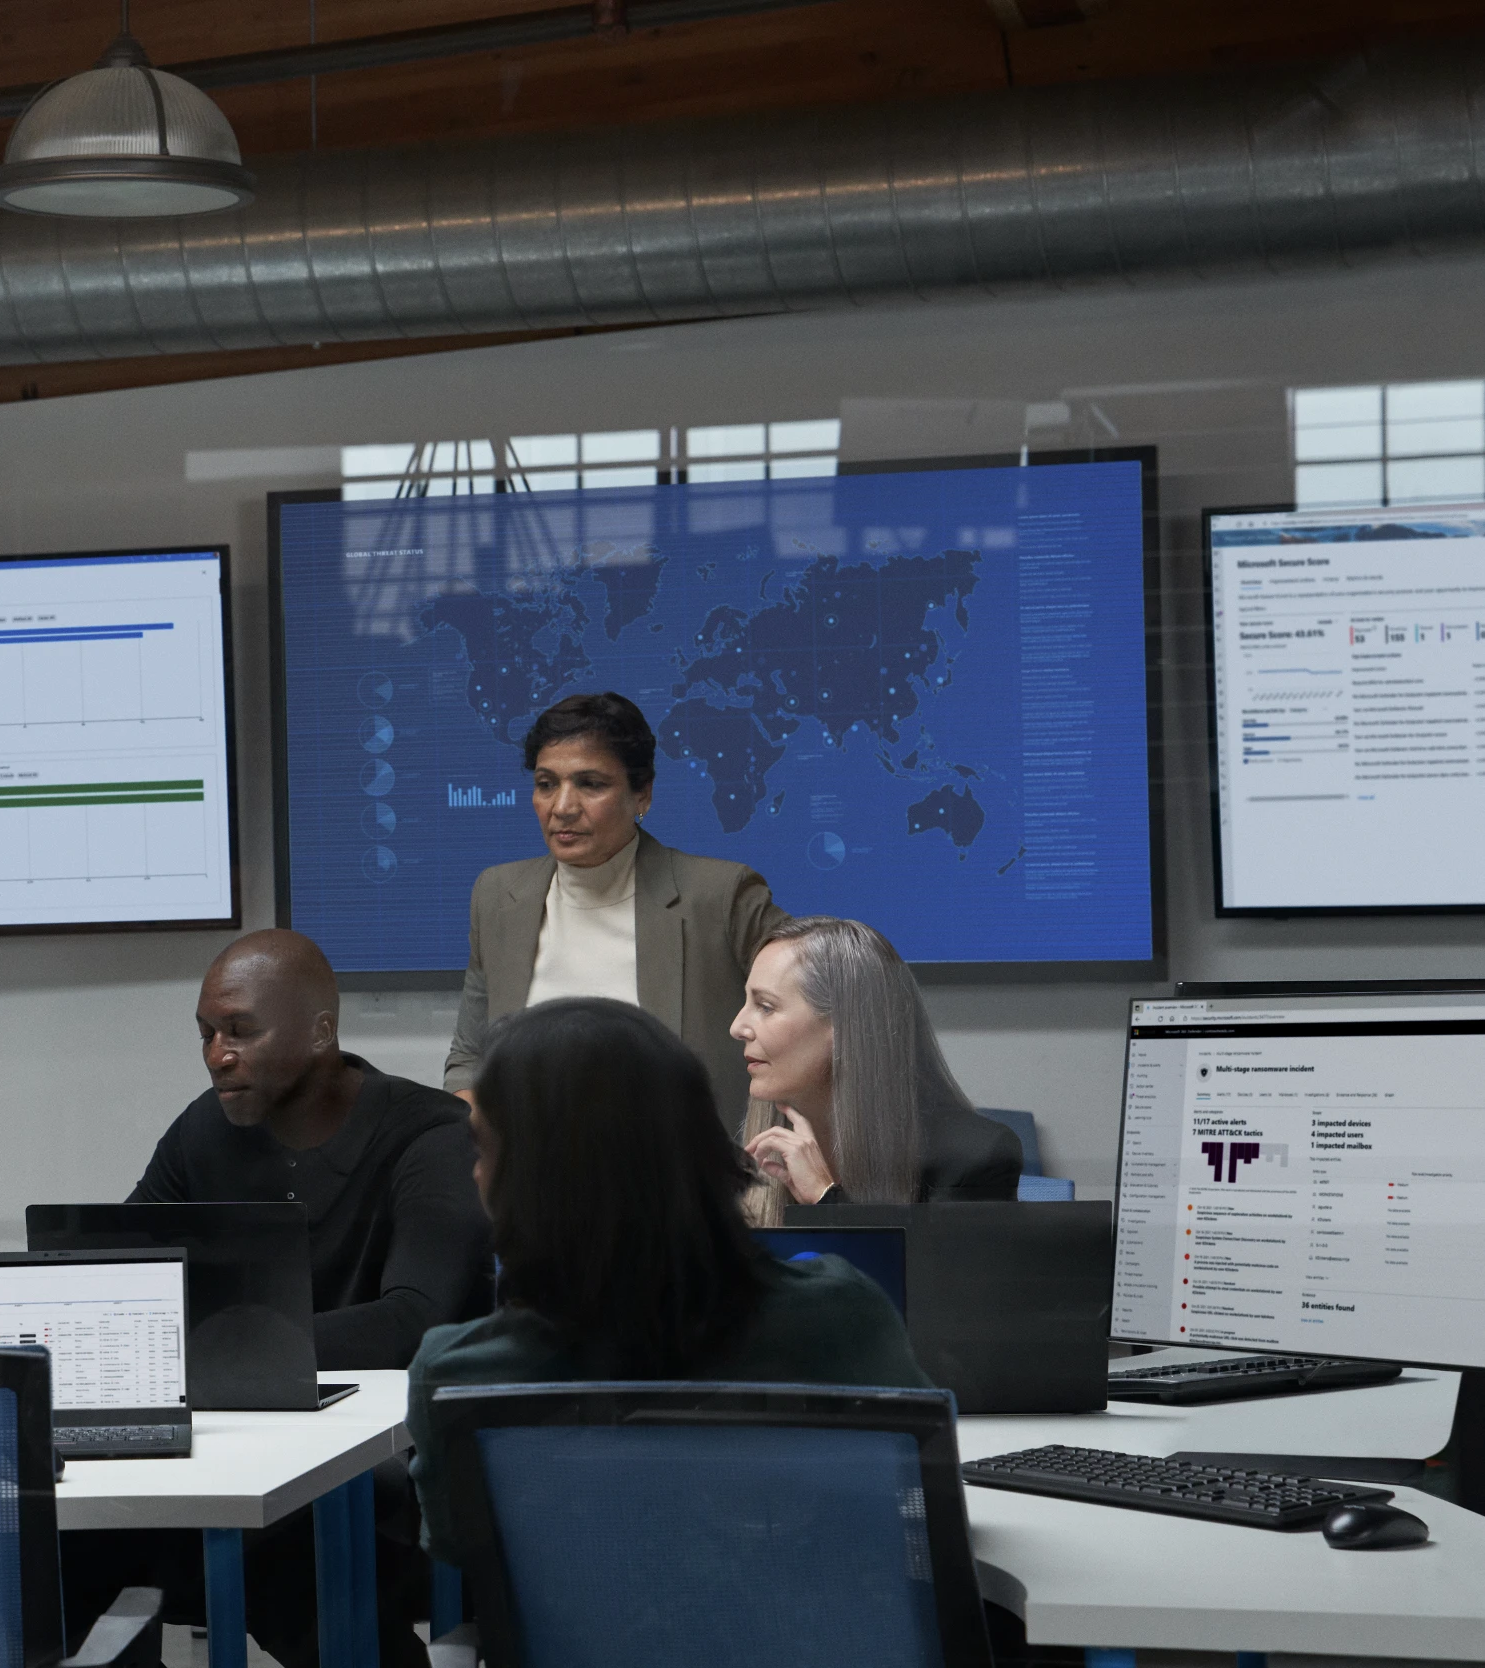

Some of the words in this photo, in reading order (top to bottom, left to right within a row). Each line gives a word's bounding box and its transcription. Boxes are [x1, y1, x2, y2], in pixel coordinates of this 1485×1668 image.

[1237, 559, 1276, 569] Microsoft
[1278, 558, 1304, 567] Secure
[1306, 558, 1329, 566] Score
[1239, 632, 1267, 640] Secure
[1269, 631, 1293, 639] Score:
[1295, 630, 1324, 639] 43.61%
[1216, 1065, 1250, 1073] Multi-stage
[1317, 1120, 1346, 1128] impacted
[1317, 1131, 1346, 1139] impacted
[1316, 1142, 1345, 1150] impacted
[1301, 1302, 1309, 1310] 36
[1311, 1302, 1335, 1311] entities
[1337, 1304, 1355, 1312] found
